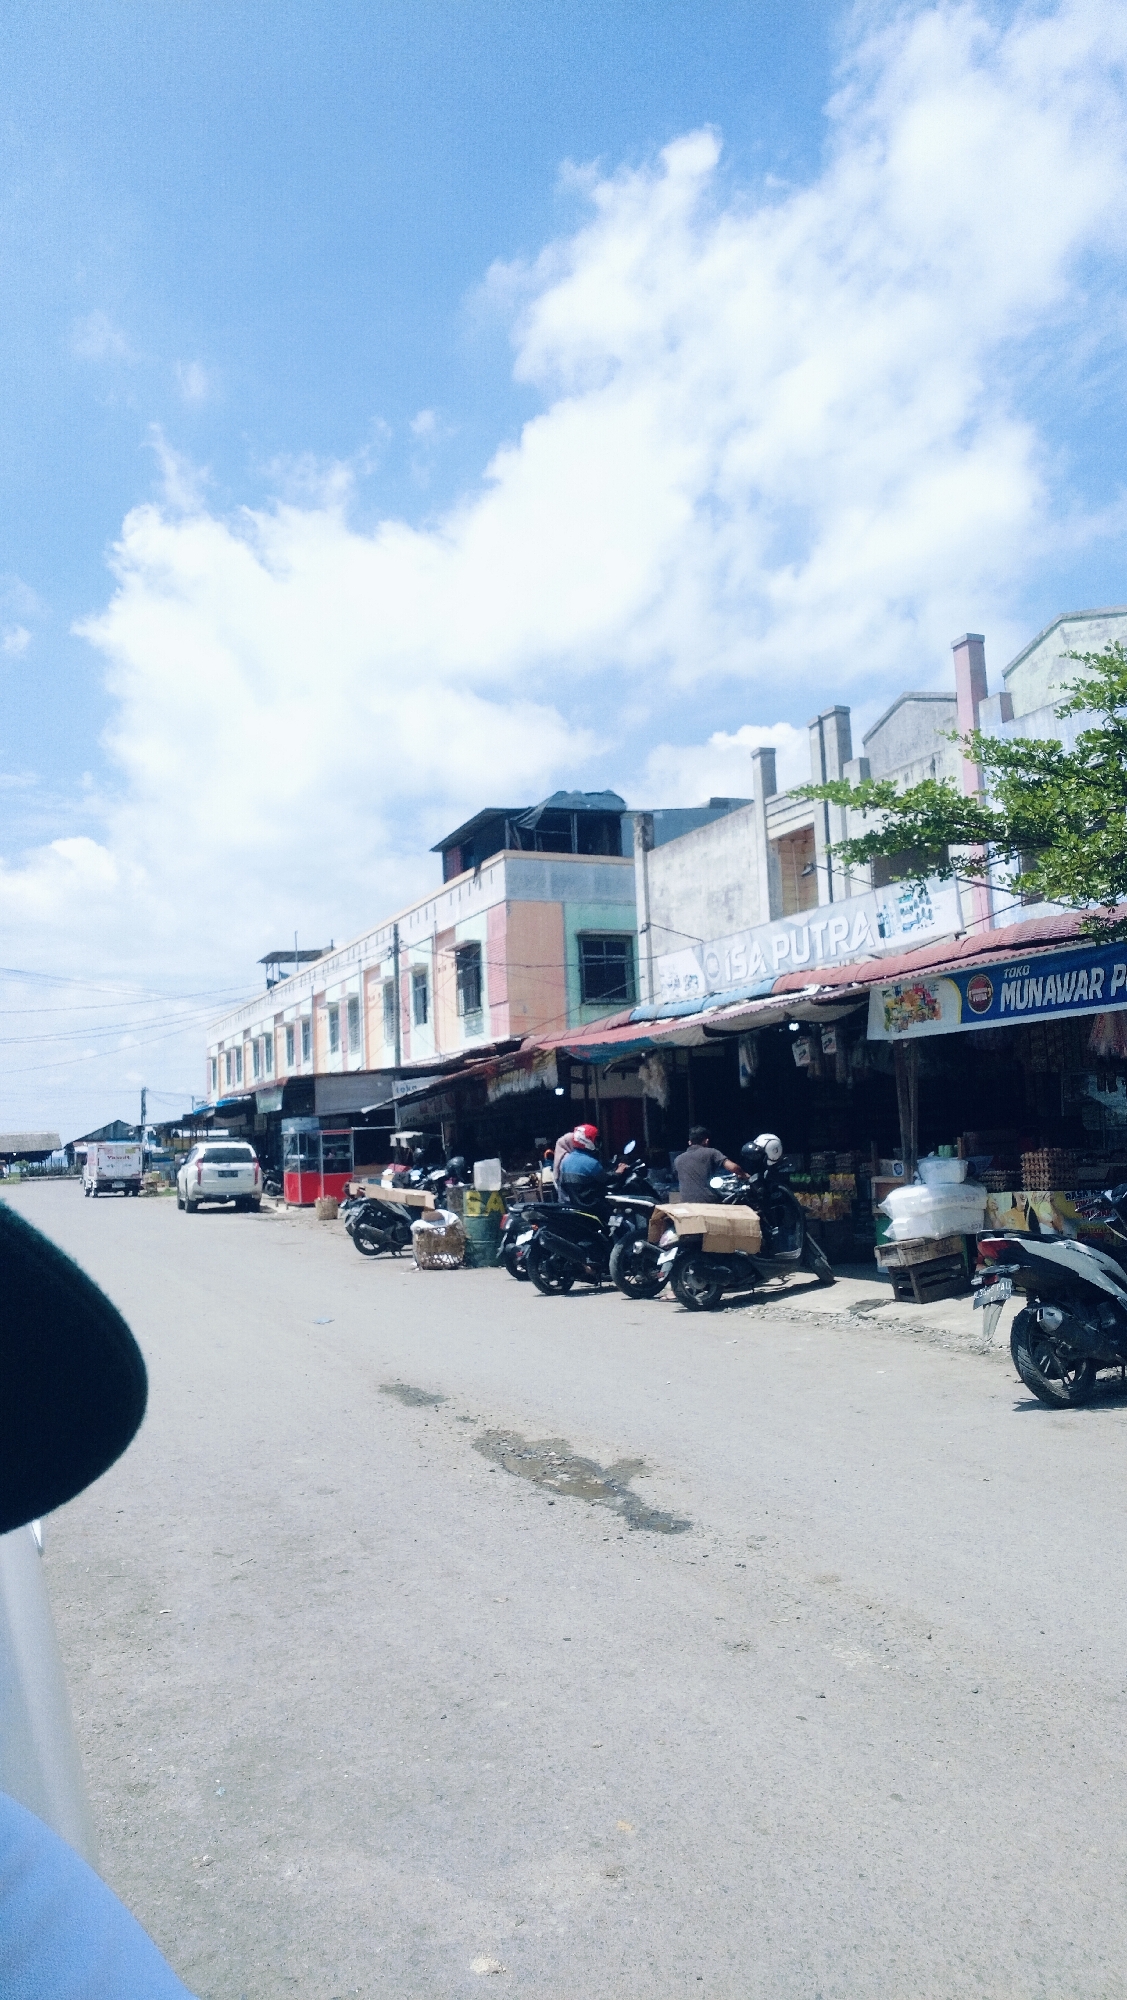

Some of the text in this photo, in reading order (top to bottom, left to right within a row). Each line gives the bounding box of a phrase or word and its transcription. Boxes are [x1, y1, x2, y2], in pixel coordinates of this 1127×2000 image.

[770, 910, 876, 971] PUTRA
[1000, 963, 1127, 1012] MUNAWAR P
[1004, 964, 1031, 979] TOKO
